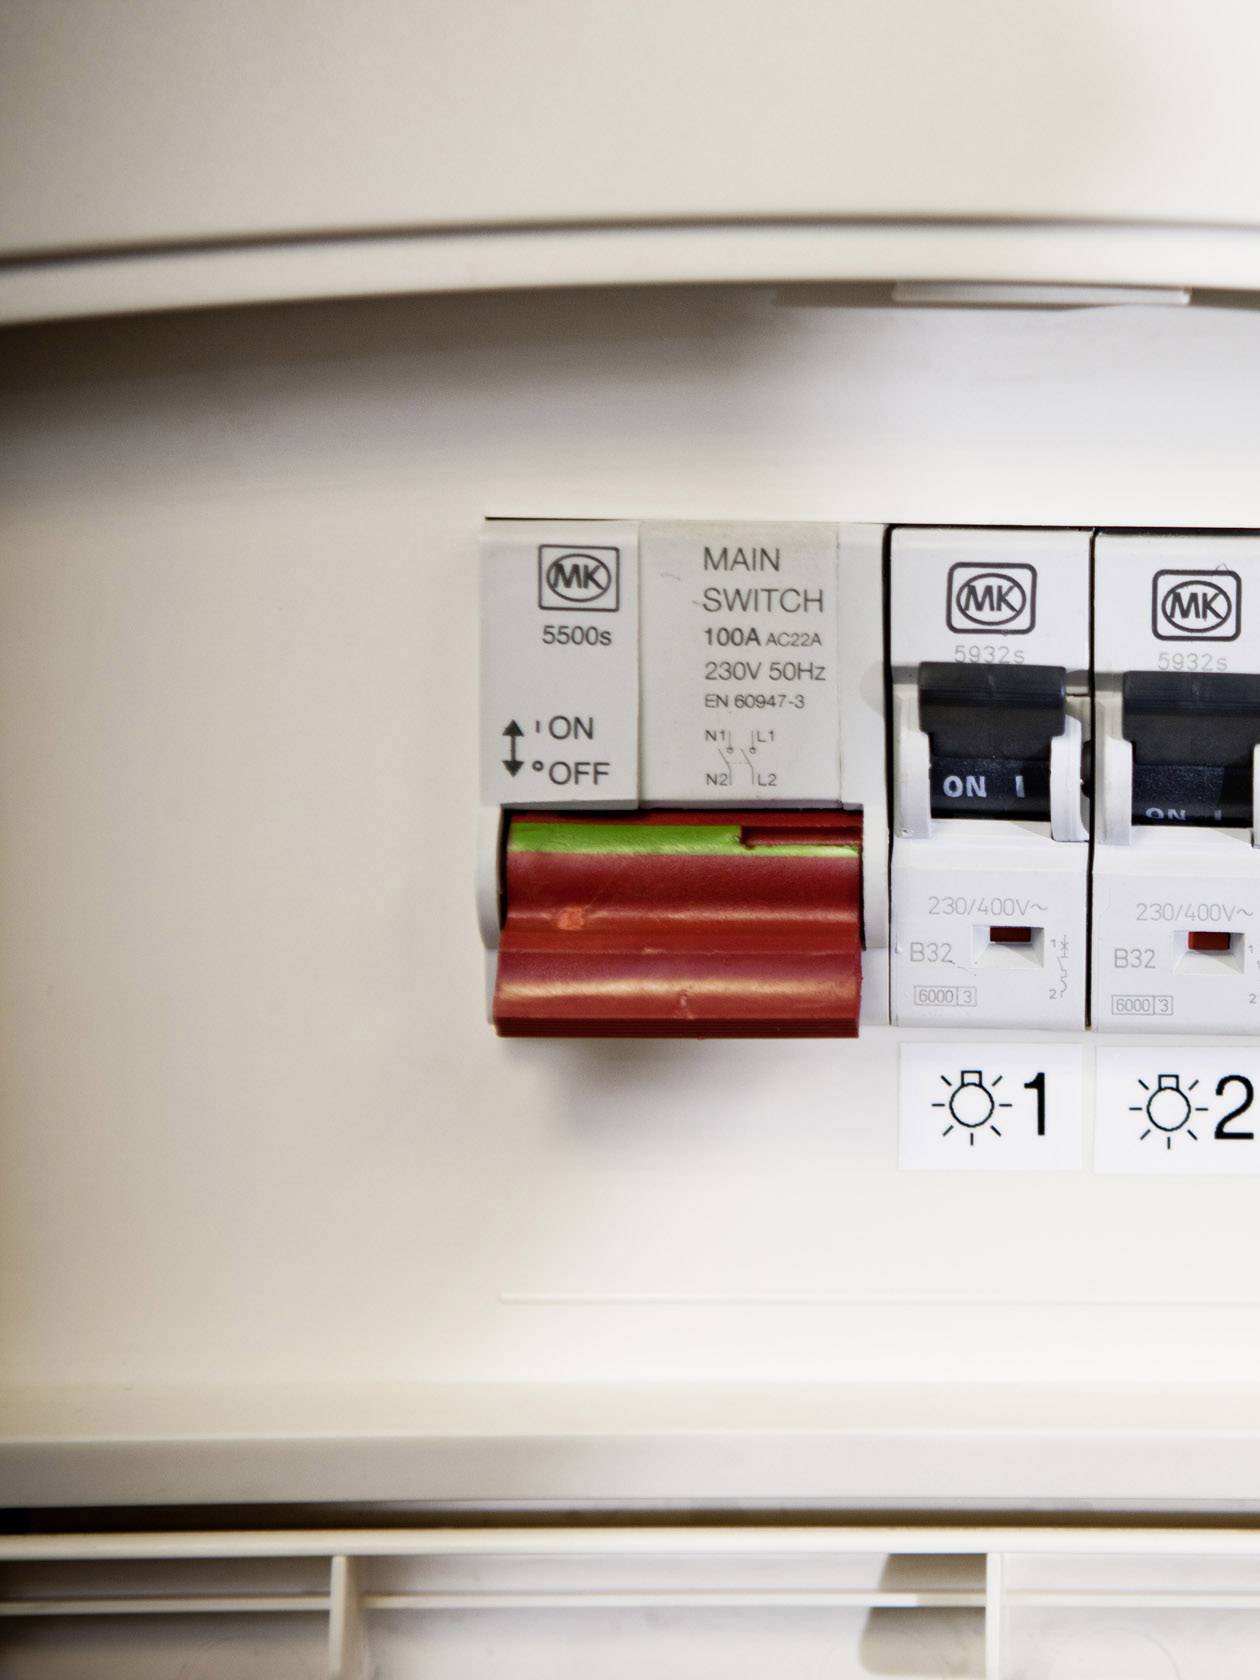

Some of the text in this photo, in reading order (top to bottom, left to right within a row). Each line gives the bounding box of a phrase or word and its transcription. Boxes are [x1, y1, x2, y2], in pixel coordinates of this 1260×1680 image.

[703, 546, 780, 572] MAIN
[550, 562, 603, 590] MK
[701, 587, 825, 614] SWITCH
[963, 584, 1019, 613] MK
[1168, 591, 1225, 620] MK
[541, 624, 613, 647] 5500s
[704, 627, 823, 648] 100A AC22A
[954, 644, 1026, 665] 5932s
[1157, 651, 1228, 673] 5932s
[704, 661, 827, 682] 230V 50Hz
[704, 693, 806, 709] EN 60947-3
[547, 715, 595, 741] ON
[704, 728, 727, 742] N1
[755, 729, 775, 743] L1
[547, 761, 611, 786] OFF
[705, 772, 729, 787] N2
[756, 773, 778, 787] L2
[942, 774, 988, 799] ON
[909, 941, 953, 963] B32
[1113, 947, 1157, 970] B32
[1023, 1071, 1046, 1136] 1
[1213, 1074, 1256, 1141] 2
